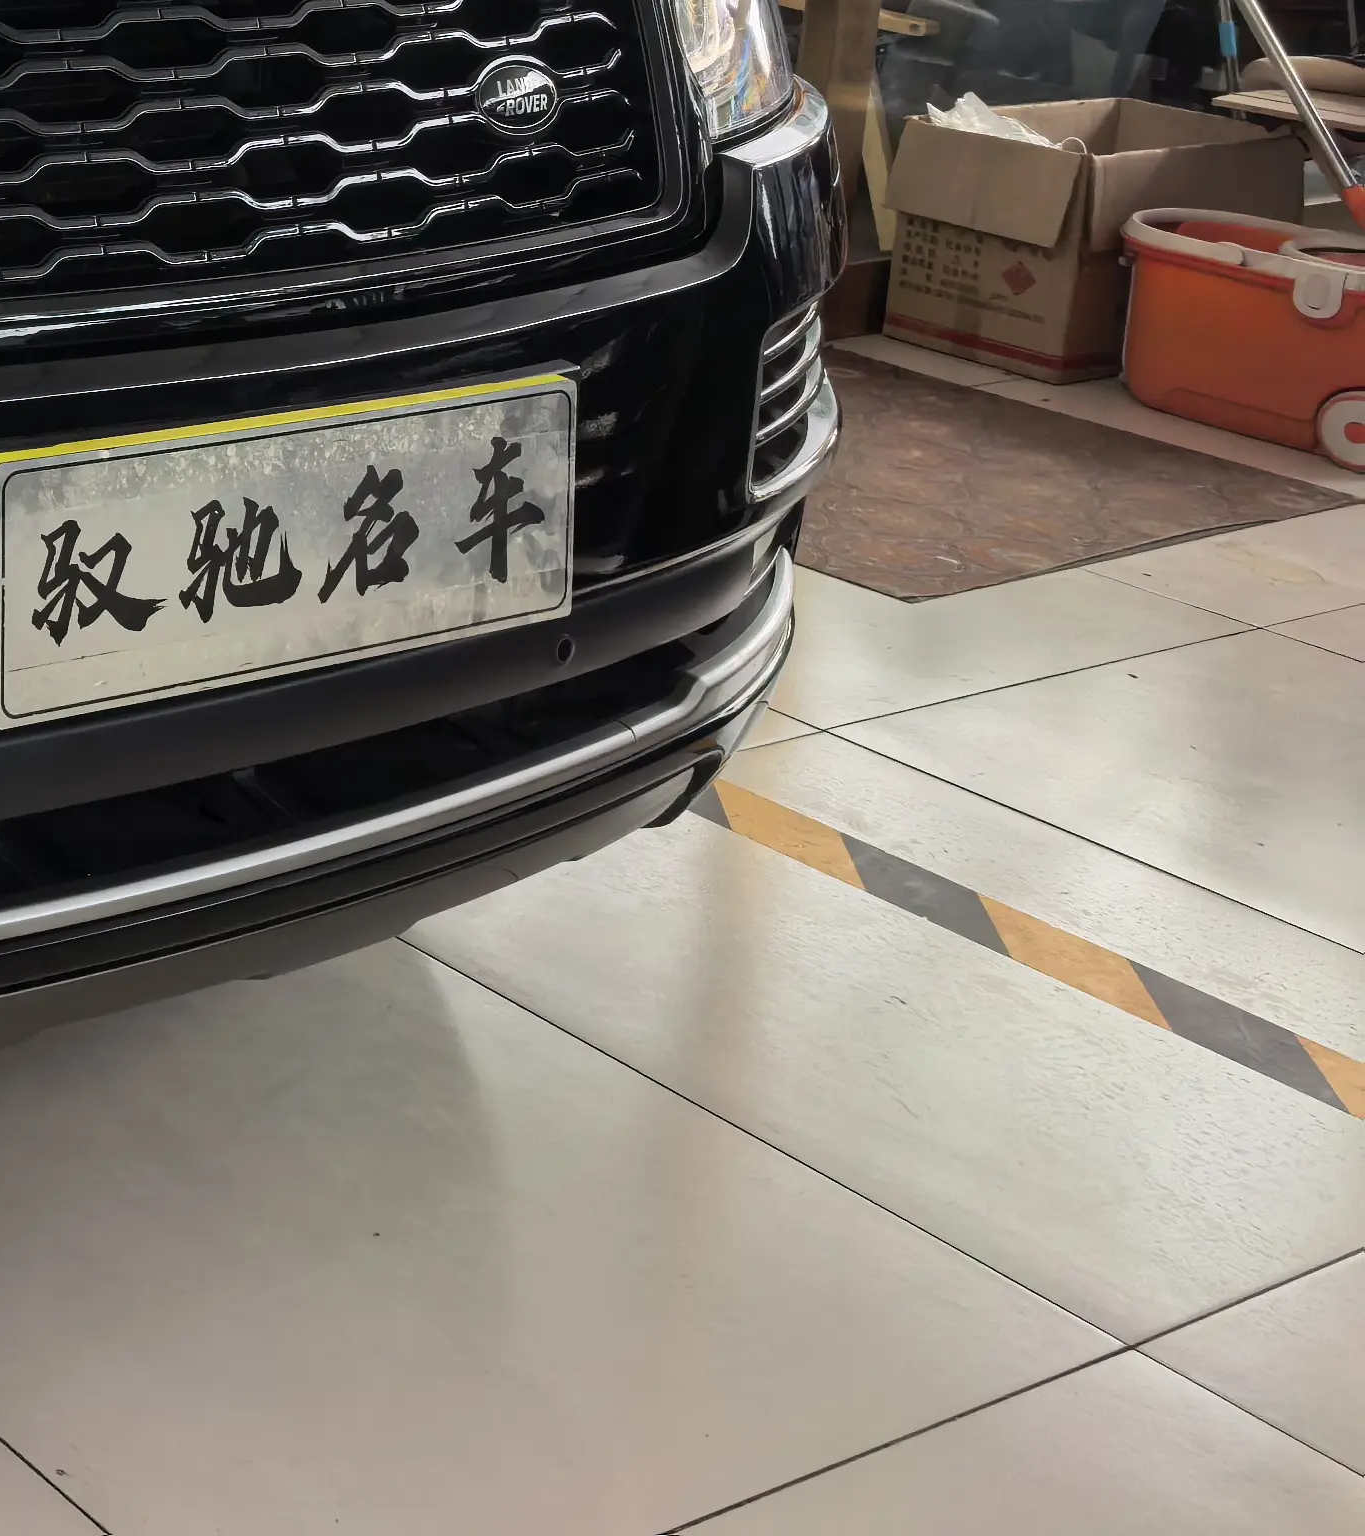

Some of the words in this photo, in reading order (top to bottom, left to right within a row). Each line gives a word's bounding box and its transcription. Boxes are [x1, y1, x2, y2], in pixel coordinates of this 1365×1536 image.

[504, 93, 548, 117] ROVER
[31, 436, 545, 646] 驭驰名车
